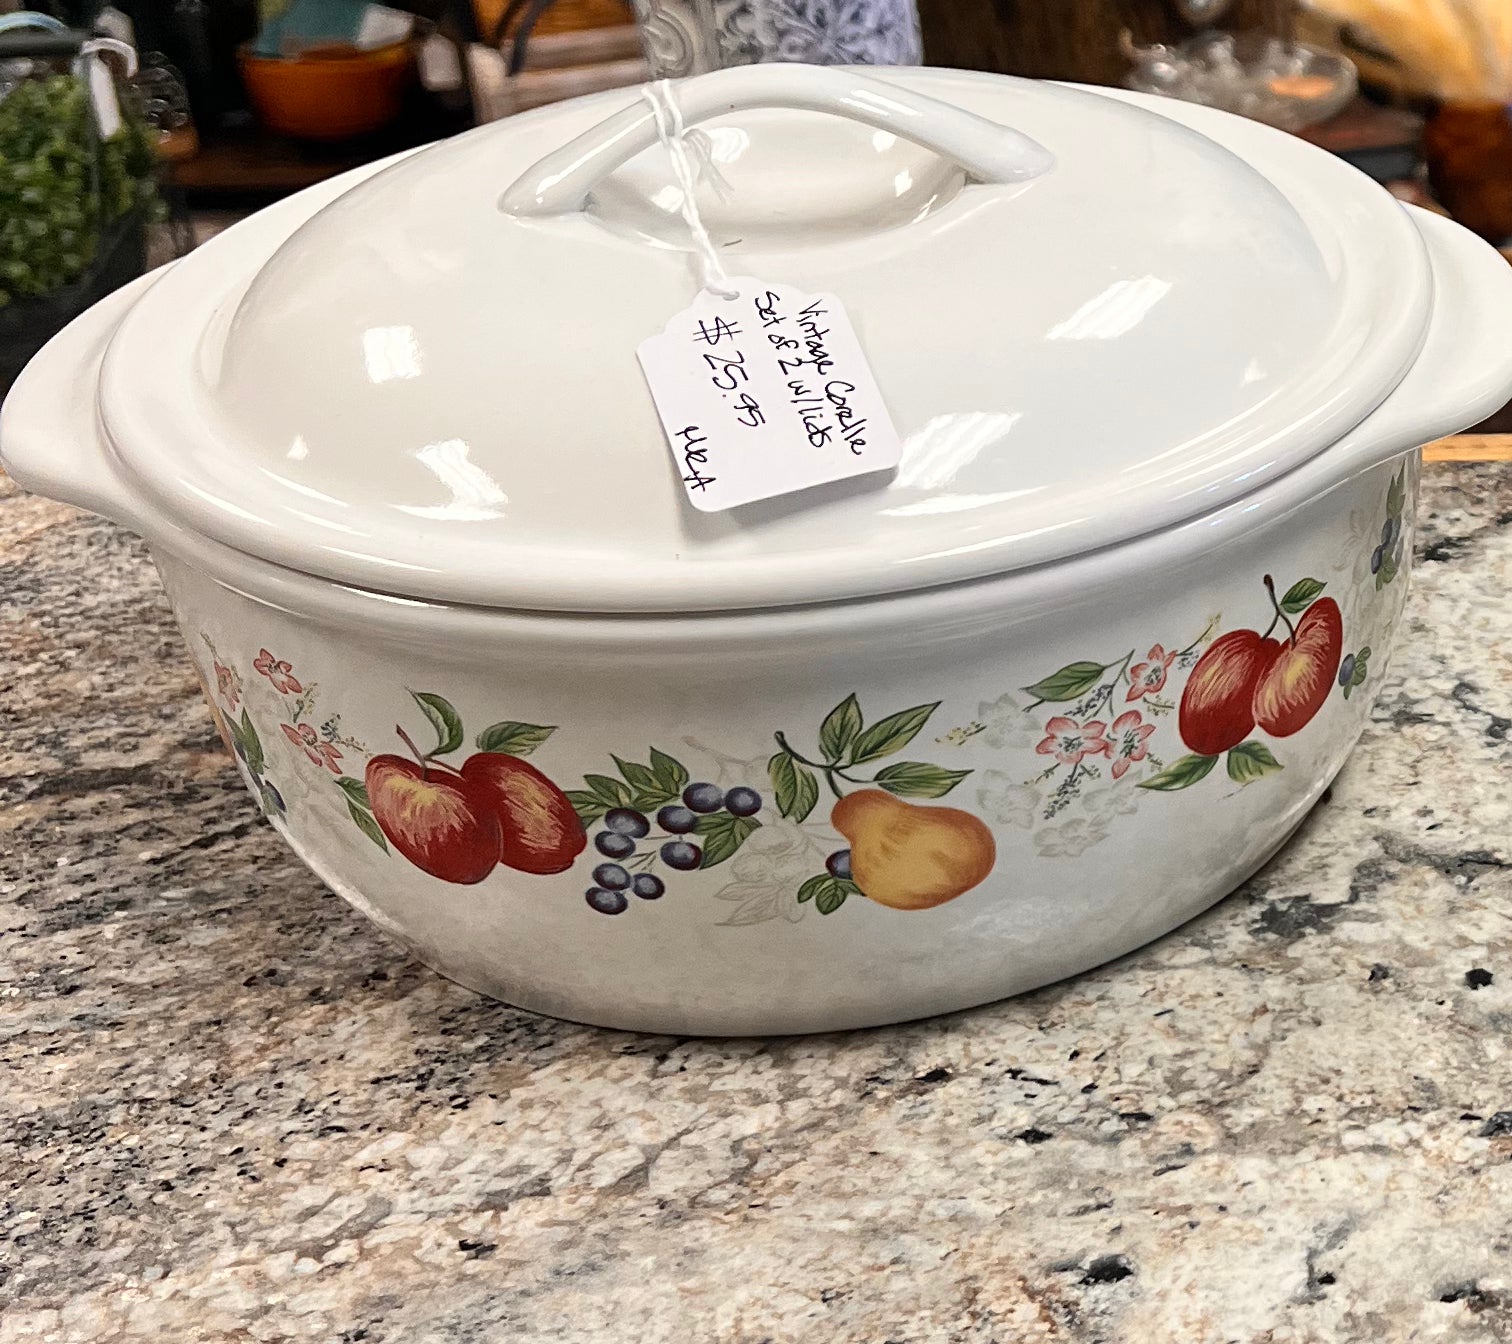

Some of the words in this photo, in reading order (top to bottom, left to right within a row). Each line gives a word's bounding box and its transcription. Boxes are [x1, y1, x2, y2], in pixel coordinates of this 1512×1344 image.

[754, 290, 787, 327] Set
[767, 333, 799, 350] of
[777, 357, 802, 375] 2
[796, 298, 834, 375] Vintage
[824, 380, 867, 456] Corelle
